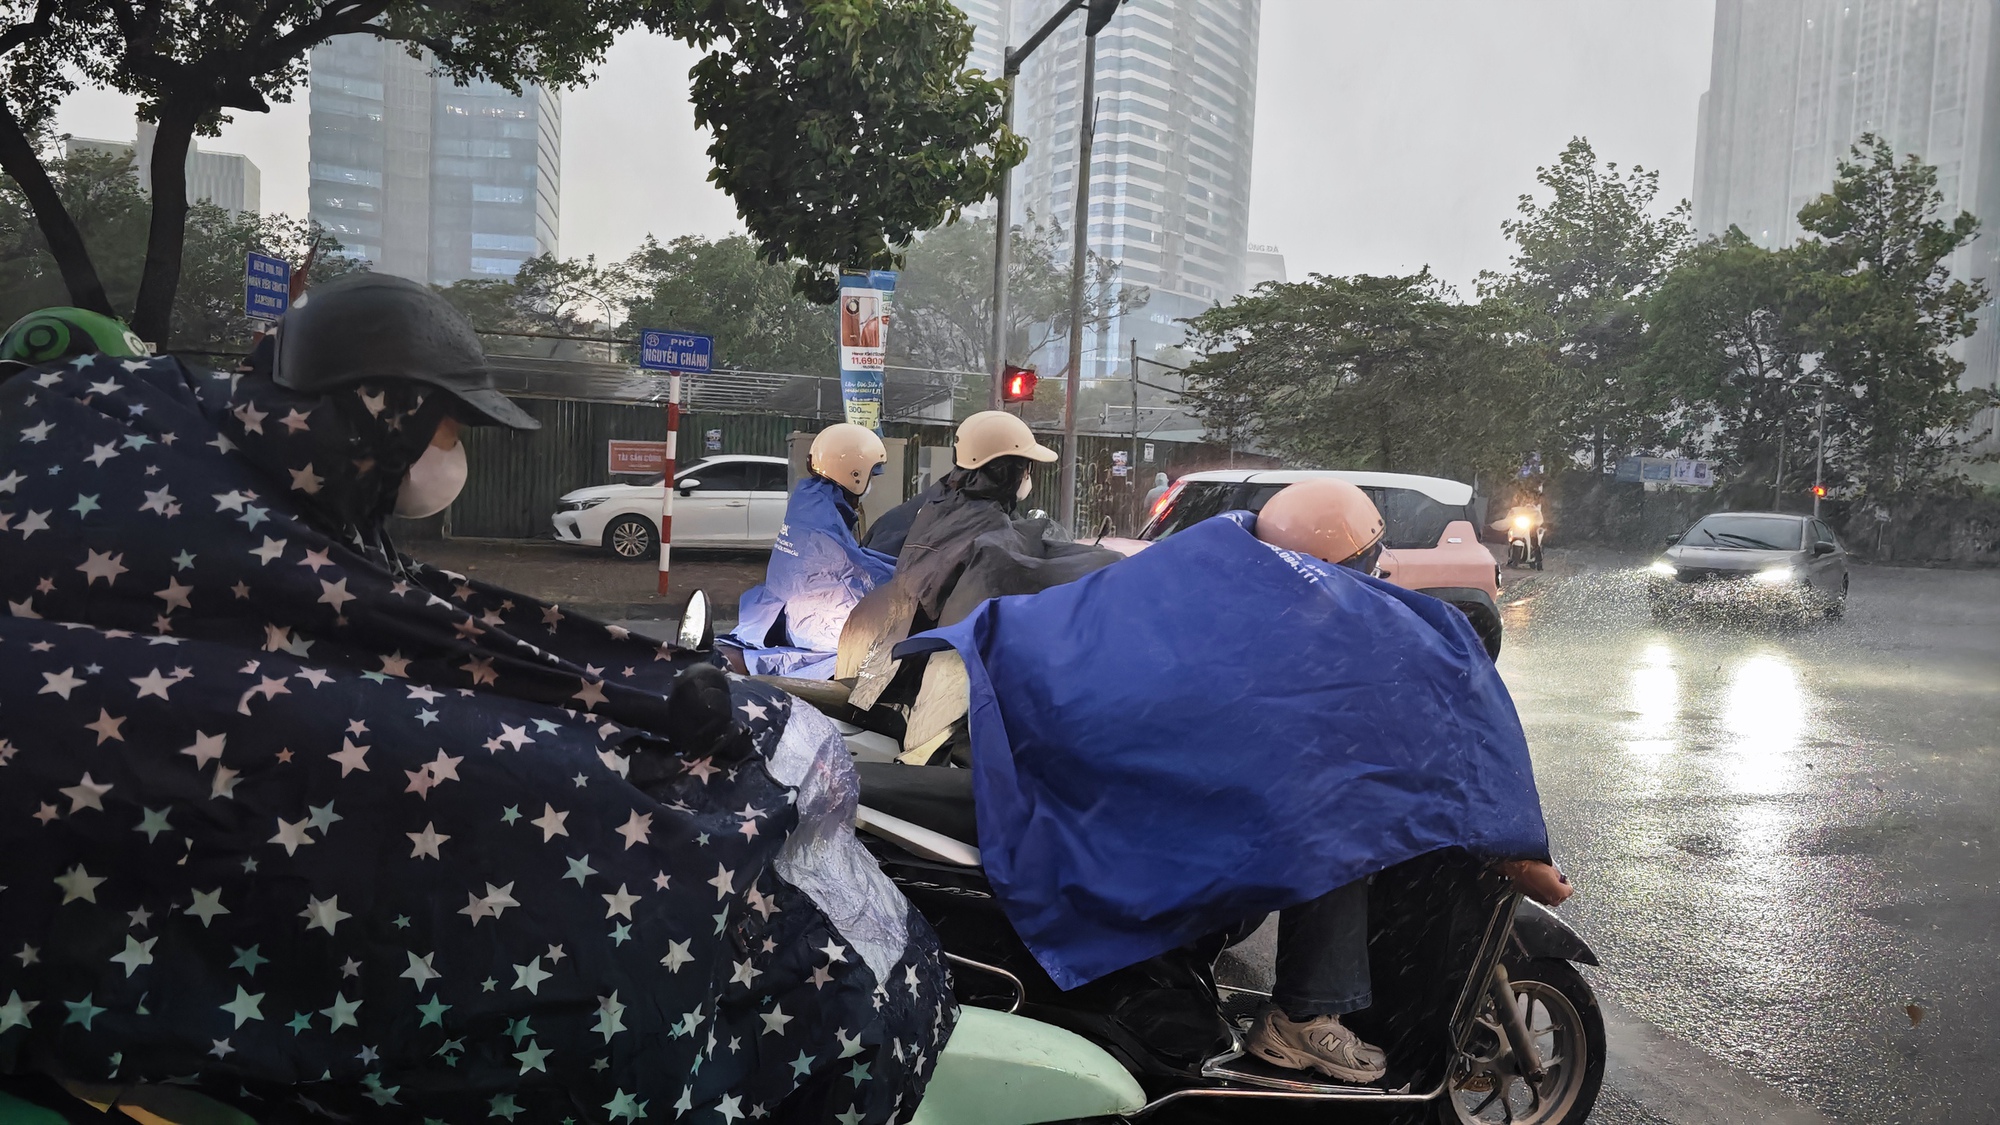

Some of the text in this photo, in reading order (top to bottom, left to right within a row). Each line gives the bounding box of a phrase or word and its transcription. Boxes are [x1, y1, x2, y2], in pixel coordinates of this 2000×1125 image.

[670, 336, 695, 347] PHỐ
[680, 350, 708, 367] CHÁNH
[1319, 1032, 1342, 1052] N
